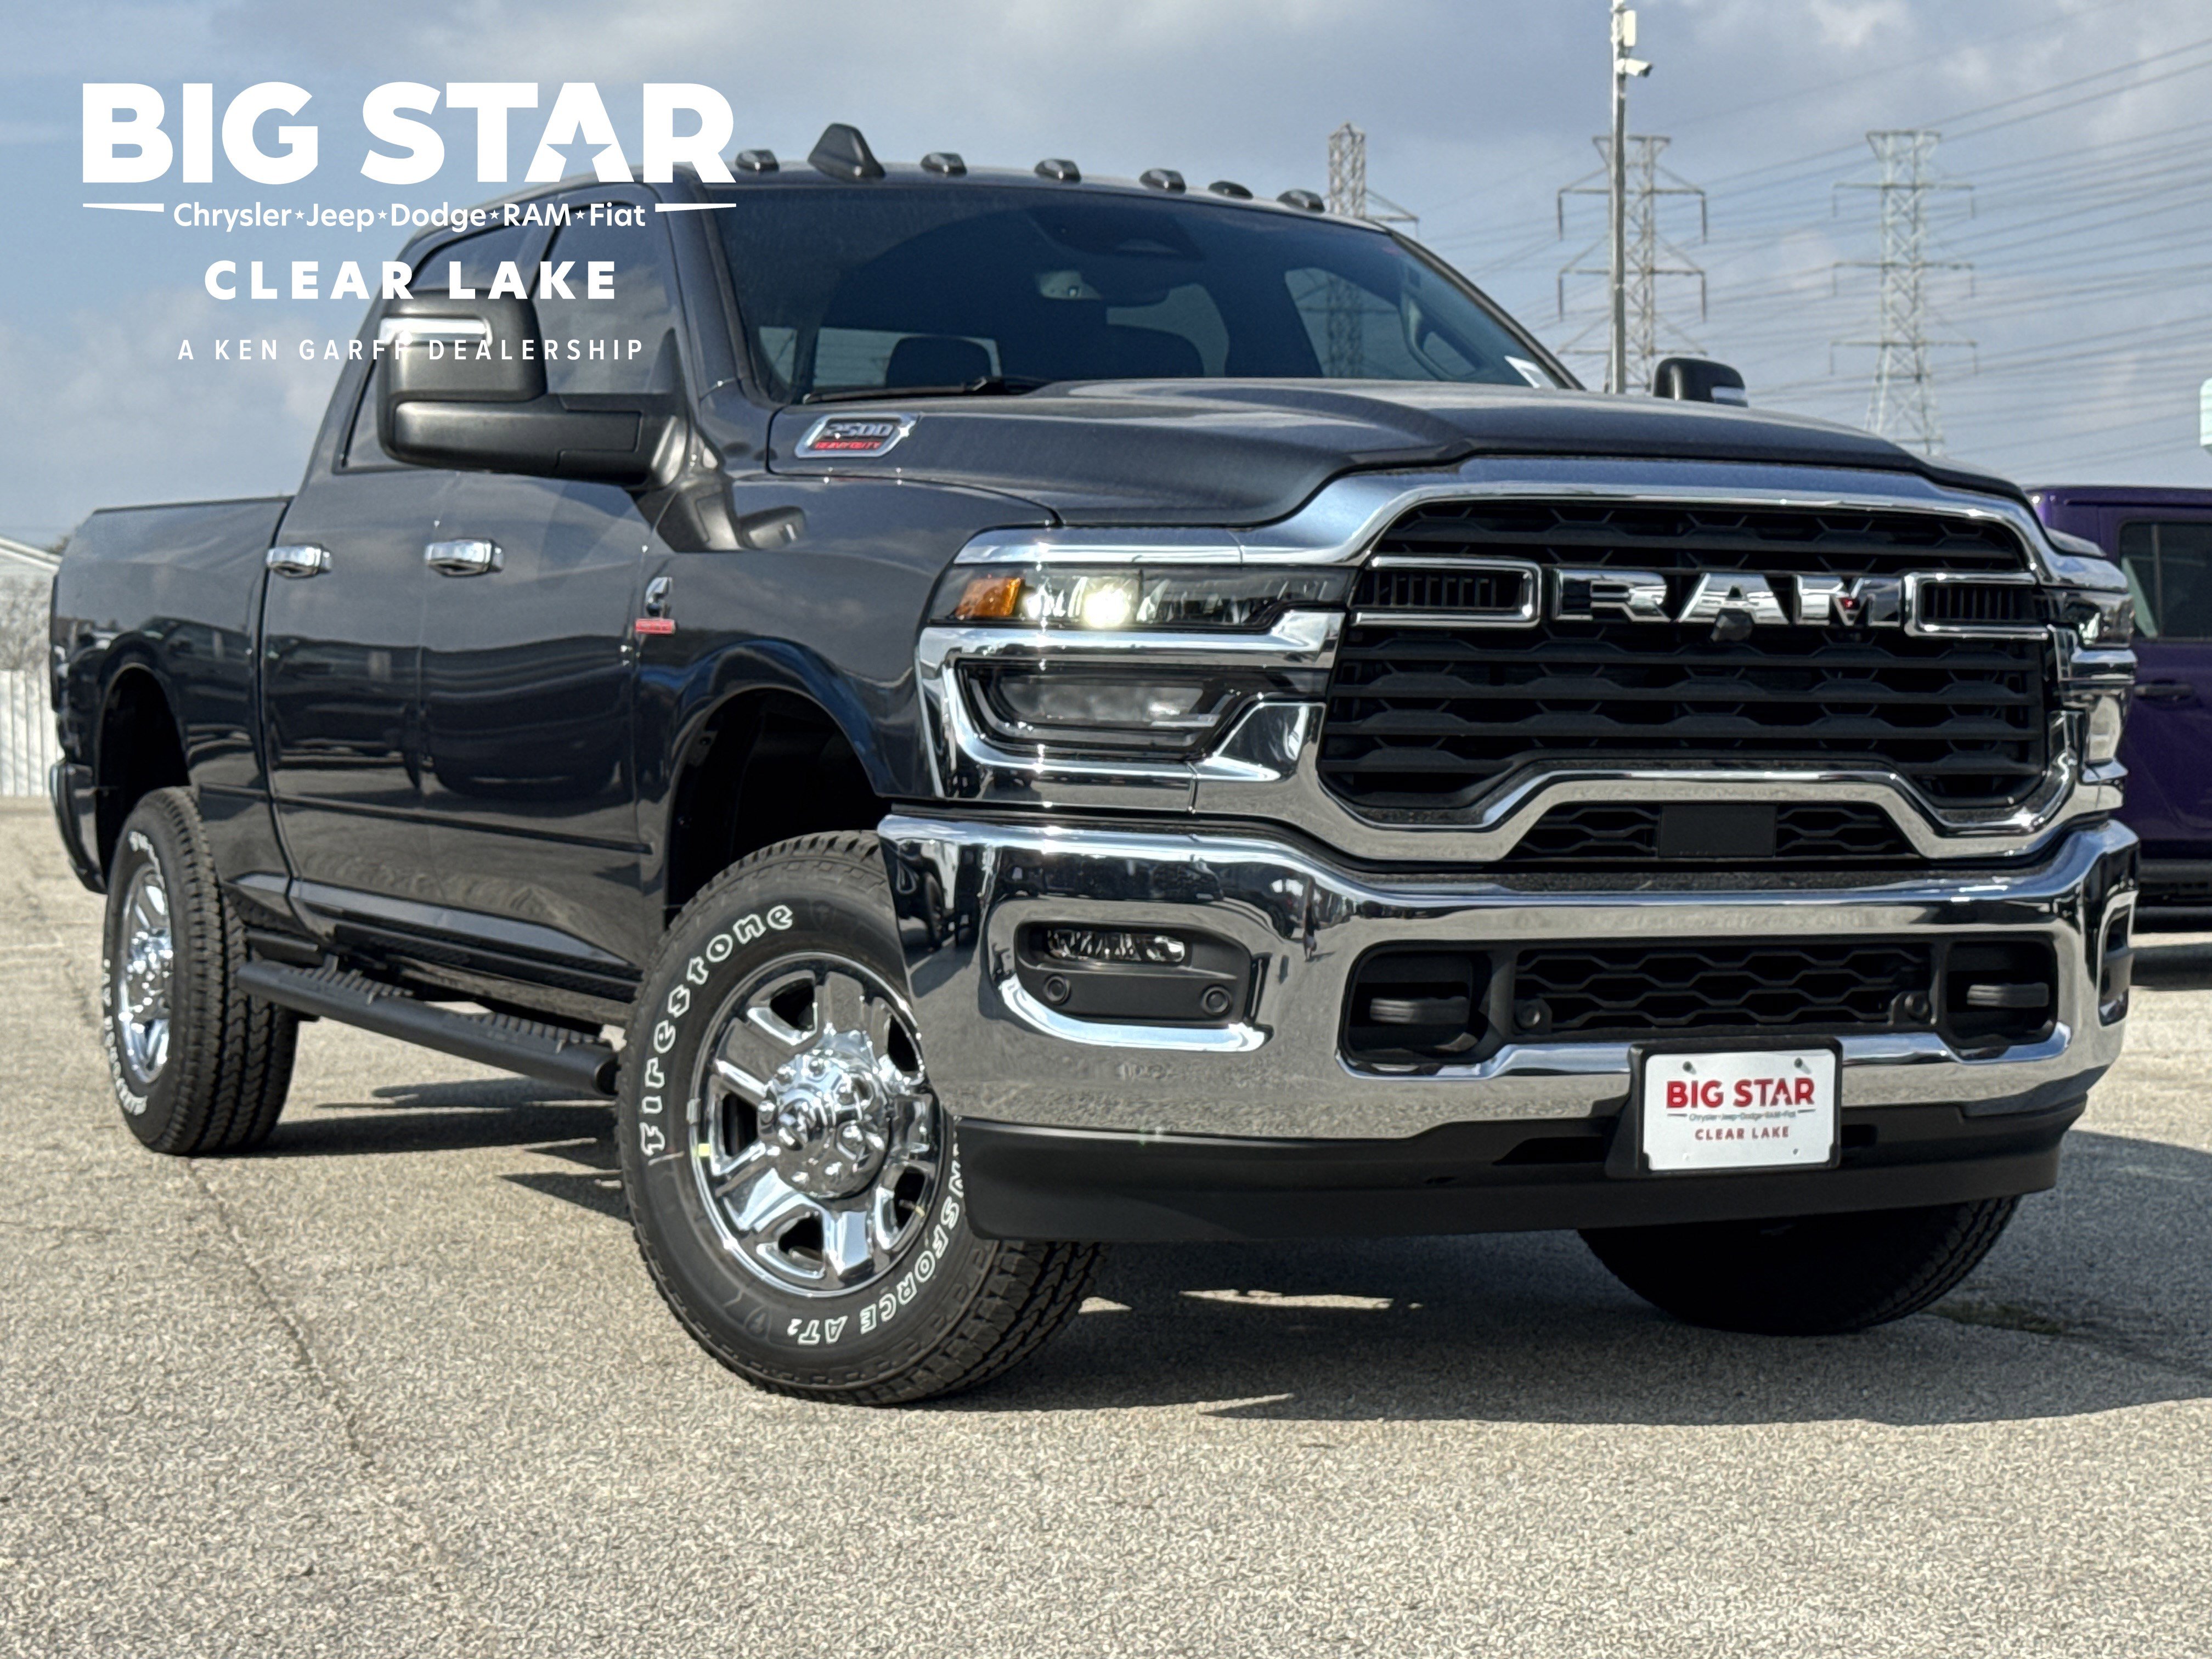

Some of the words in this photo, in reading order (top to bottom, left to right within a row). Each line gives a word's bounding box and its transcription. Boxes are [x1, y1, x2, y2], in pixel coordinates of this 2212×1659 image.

[824, 422, 894, 437] 2500
[1552, 567, 1902, 627] RAM
[1666, 1080, 1724, 1108] BIG
[1733, 1077, 1815, 1107] STAR
[1695, 1128, 1745, 1141] CLEAR
[1752, 1126, 1789, 1139] LAKE
[787, 1316, 847, 1345] AT2
